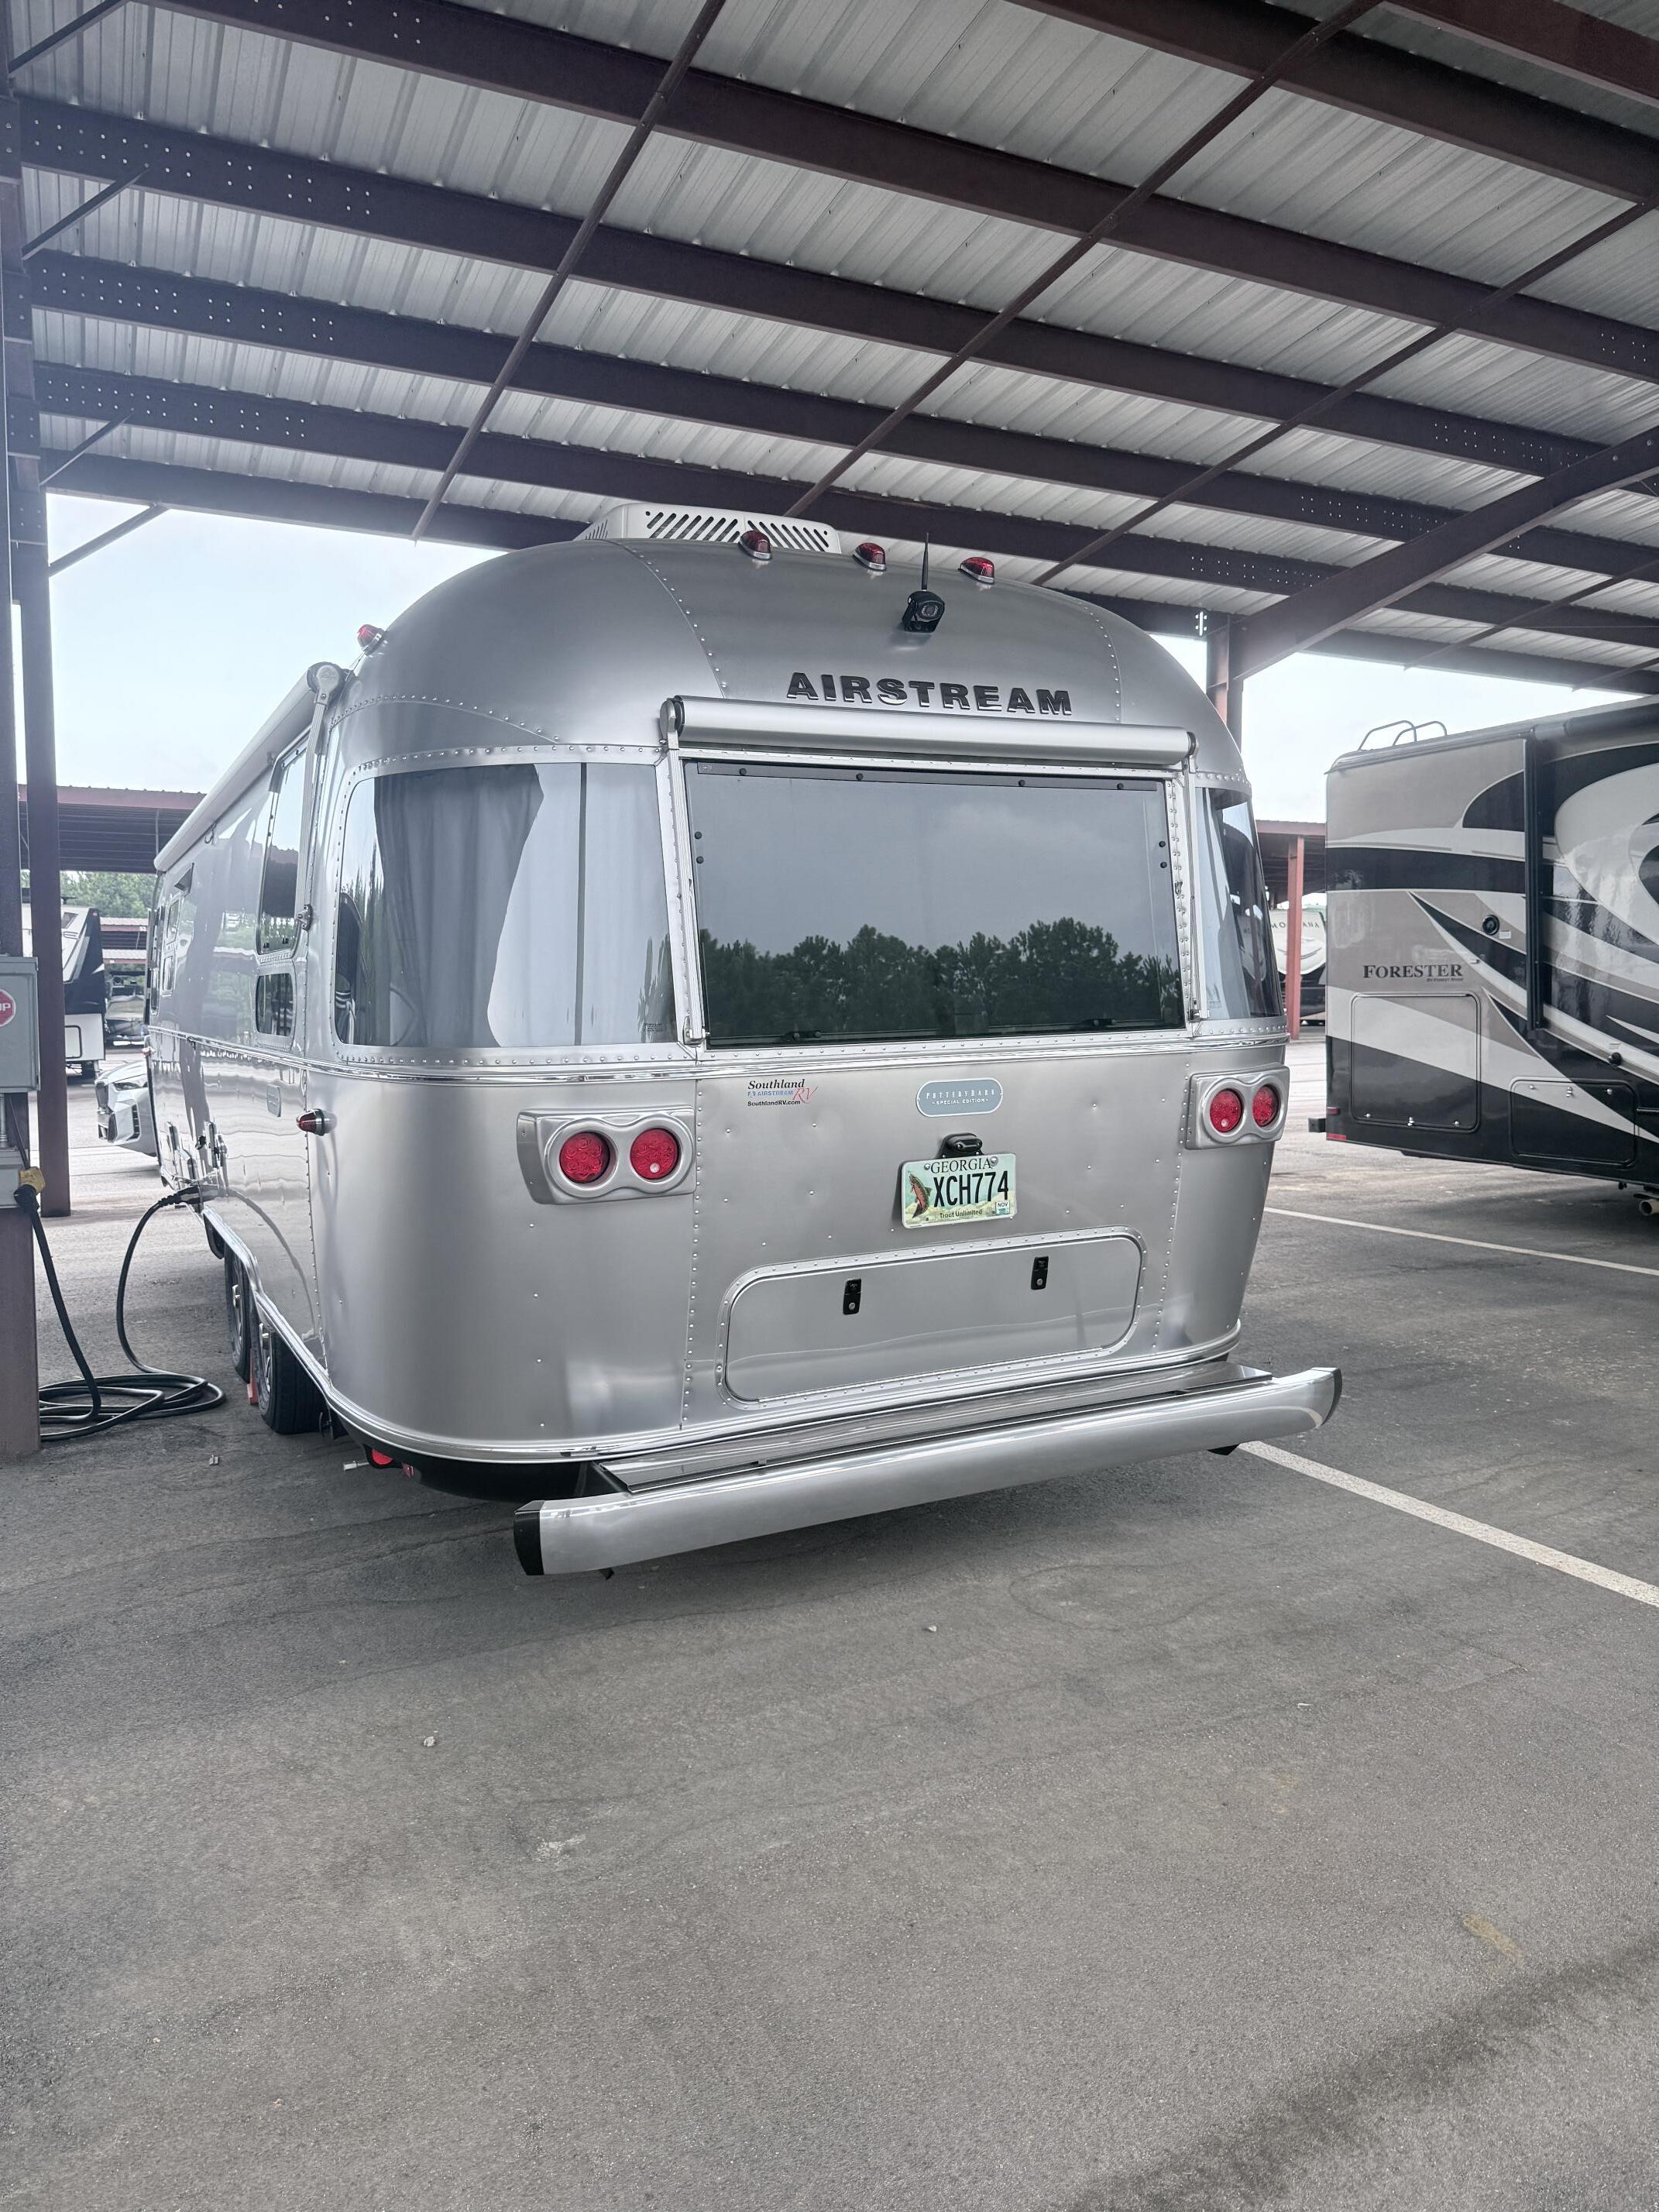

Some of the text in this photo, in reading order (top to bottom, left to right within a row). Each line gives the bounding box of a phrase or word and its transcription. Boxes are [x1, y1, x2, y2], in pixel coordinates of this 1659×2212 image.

[786, 671, 1073, 716] AIRSTREAM
[1362, 963, 1462, 978] FORESTER
[747, 1078, 805, 1090] Southland
[792, 1085, 819, 1104] RV
[931, 1156, 991, 1174] GEORGIA
[933, 1170, 1009, 1207] XCH774
